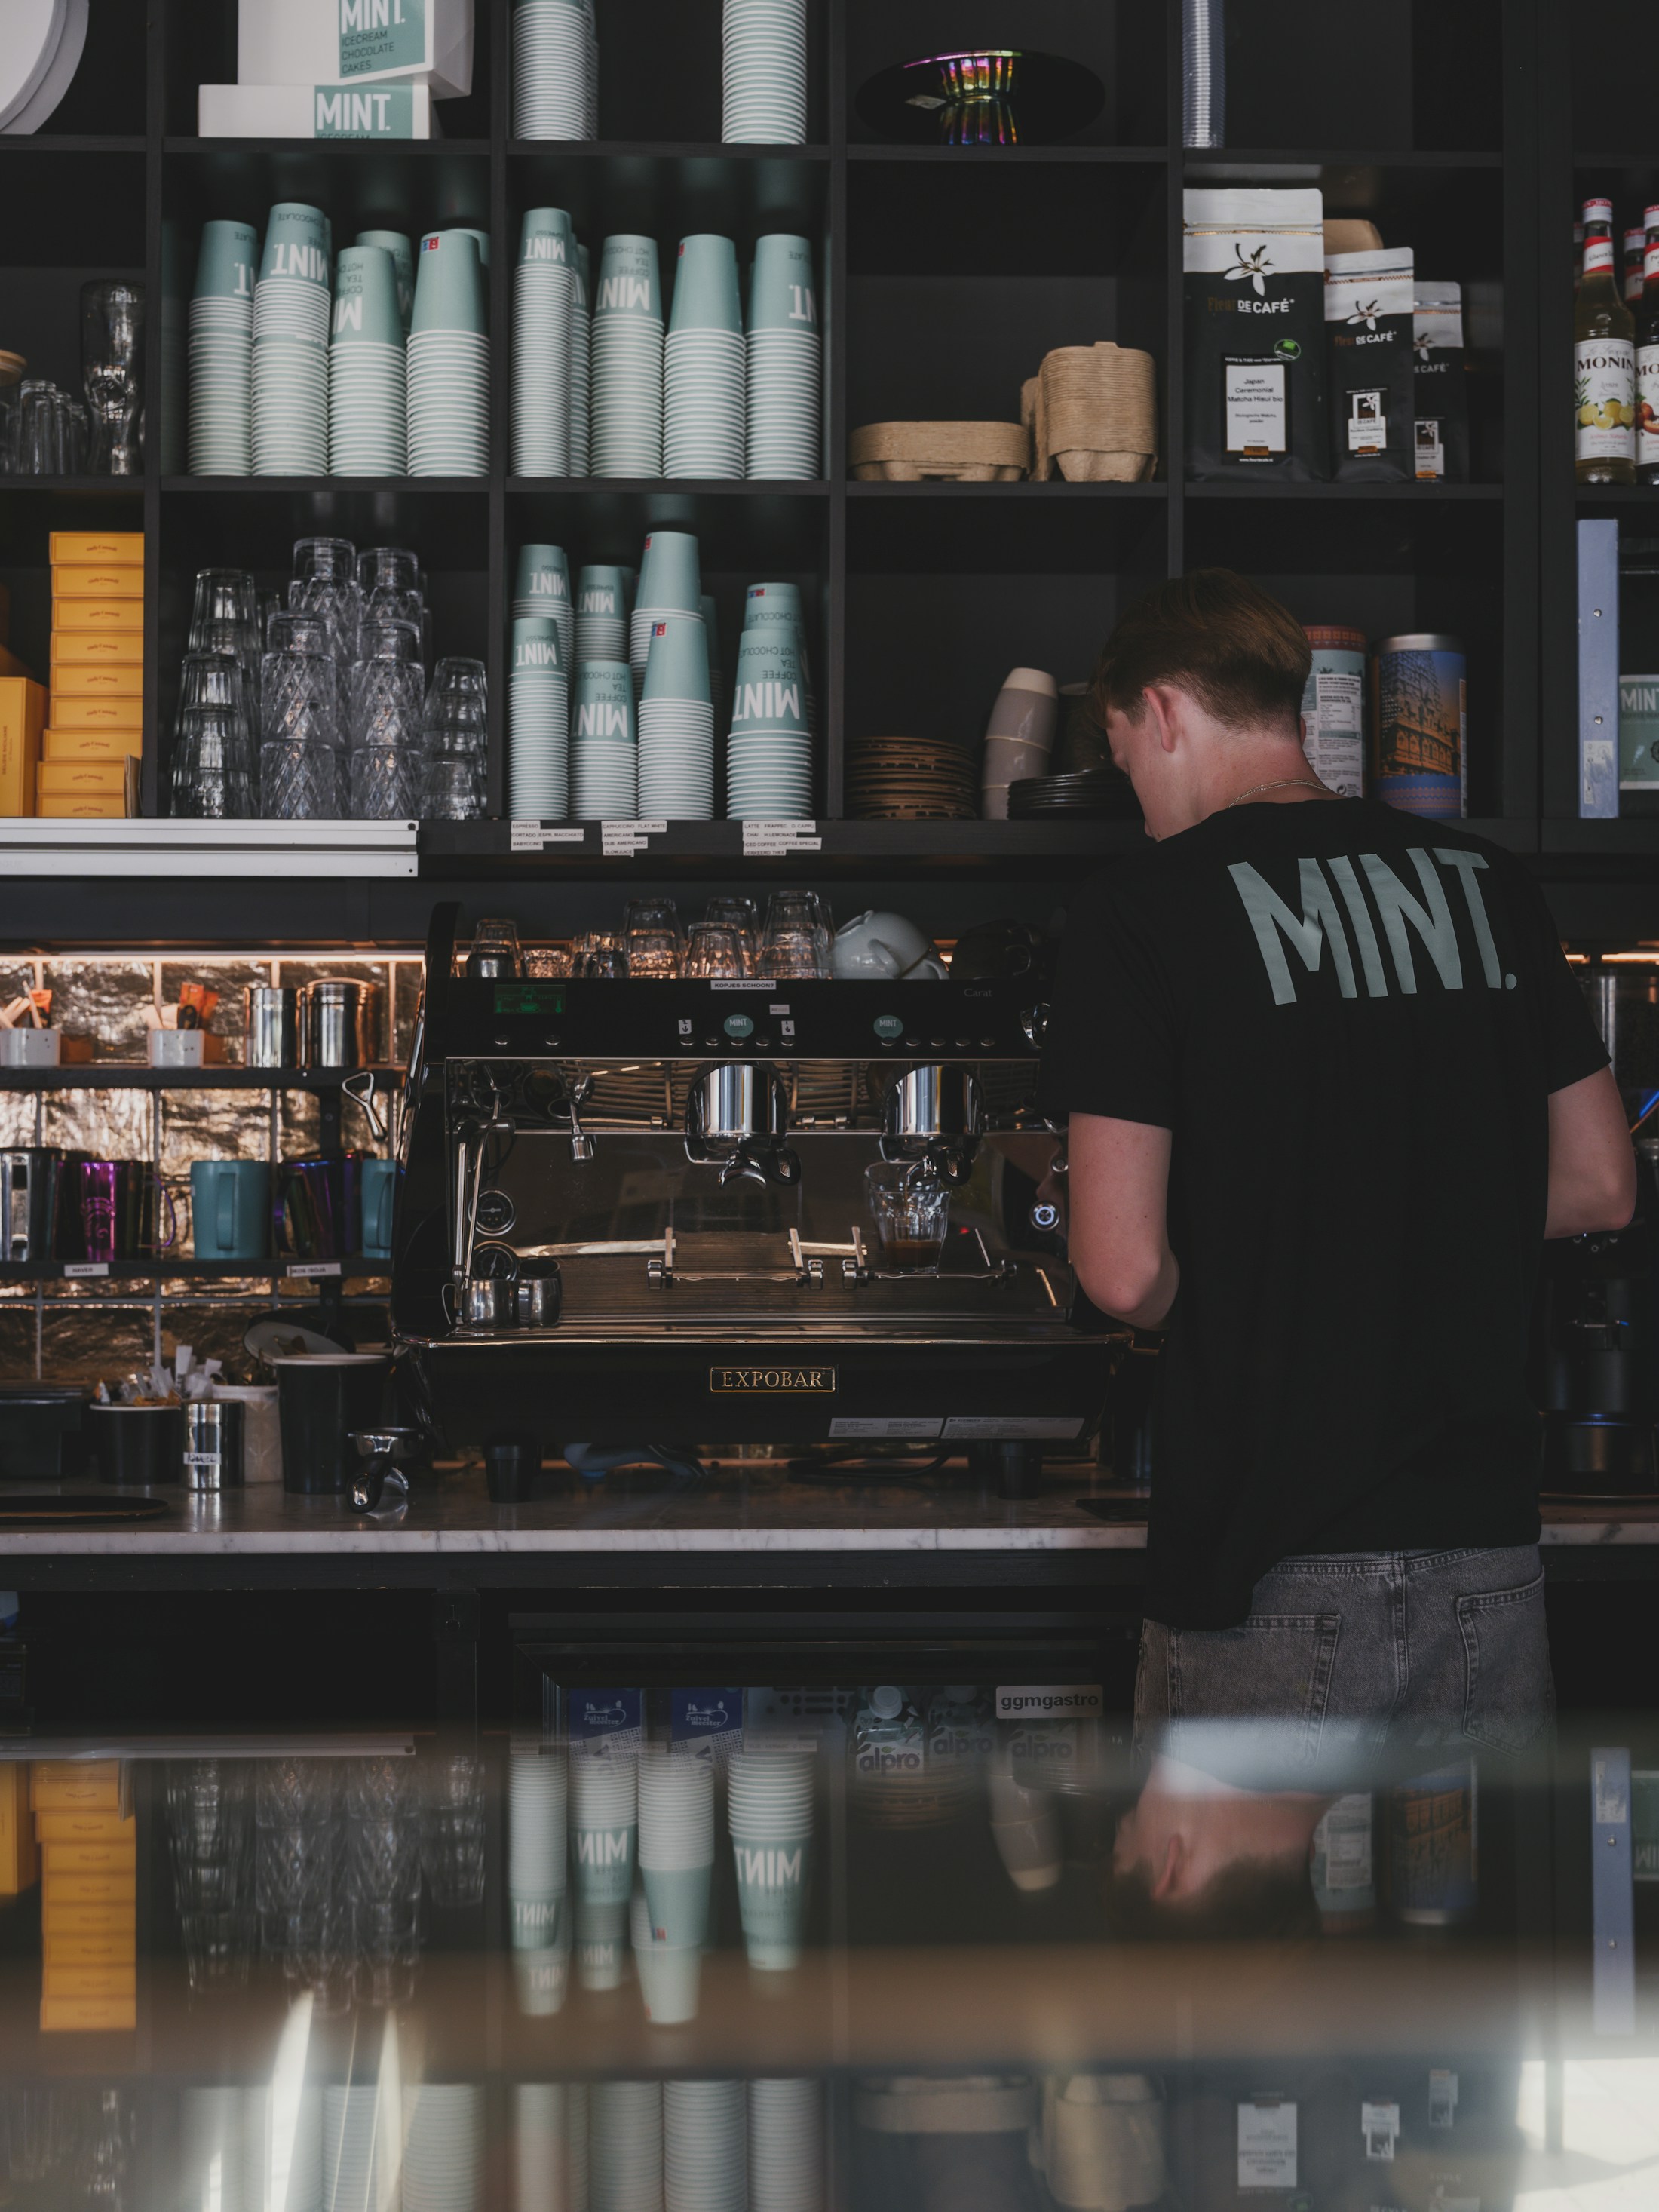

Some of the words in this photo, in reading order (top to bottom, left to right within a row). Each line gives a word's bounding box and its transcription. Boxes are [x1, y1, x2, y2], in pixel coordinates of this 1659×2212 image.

[342, 30, 388, 47] ICECREAM
[342, 42, 394, 60] CHOCOLATE
[342, 60, 373, 75] CAKES
[316, 92, 391, 132] MINT.
[346, 275, 362, 283] TEA
[618, 268, 649, 277] COFFEE
[1237, 299, 1252, 311] DE
[1577, 356, 1633, 373] MONIN
[780, 659, 796, 669] TEA
[762, 670, 796, 680] COFFEE
[612, 683, 627, 692] TEA
[595, 692, 627, 703] COFFEE
[1621, 687, 1659, 712] MIN
[1227, 848, 1517, 1005] MINT.
[964, 988, 994, 998] Carat
[720, 1370, 823, 1388] EXPOBAR
[1001, 1694, 1099, 1710] ggmgastro
[584, 1713, 609, 1723] Zuivel
[589, 1718, 620, 1726] meester
[685, 1714, 710, 1723] Zuivel
[933, 1734, 993, 1760] alpro
[1011, 1735, 1072, 1762] alpro
[859, 1747, 920, 1775] alpro
